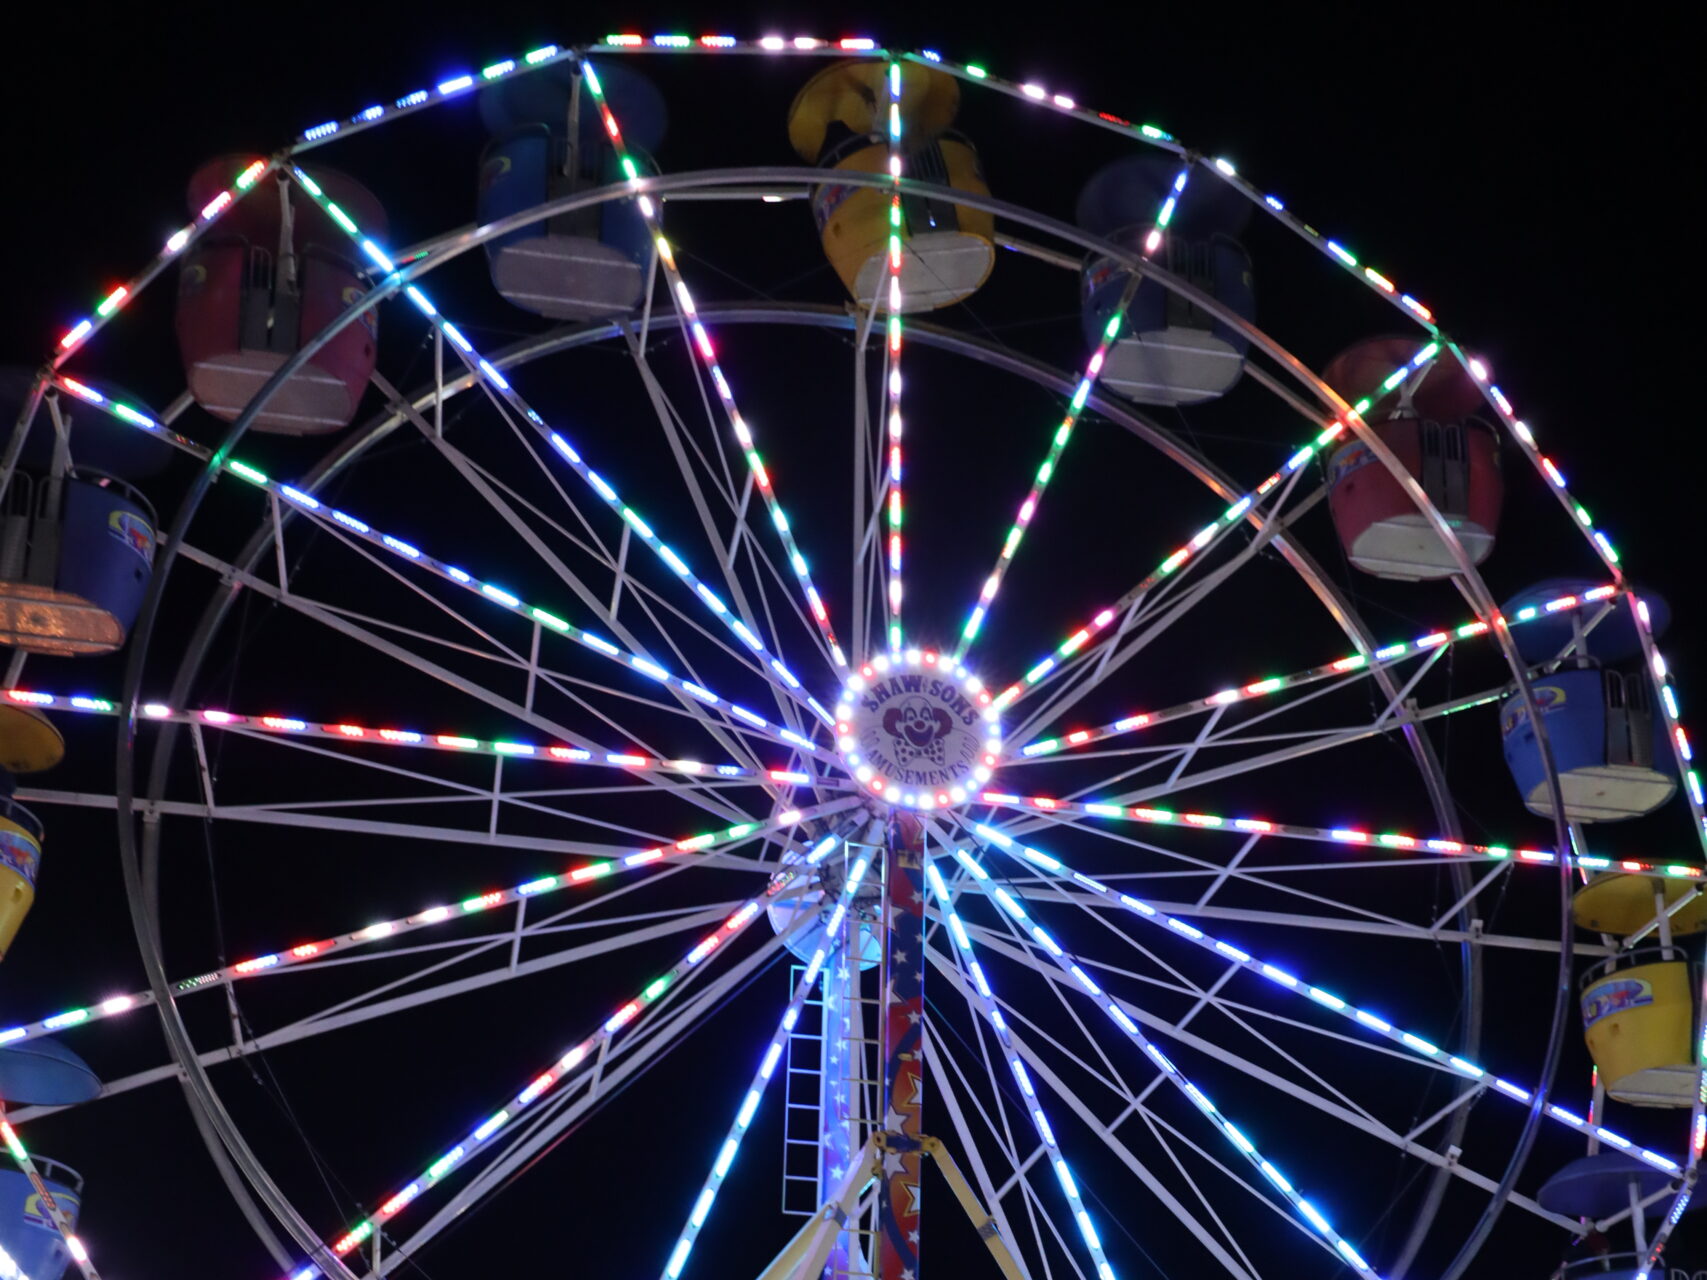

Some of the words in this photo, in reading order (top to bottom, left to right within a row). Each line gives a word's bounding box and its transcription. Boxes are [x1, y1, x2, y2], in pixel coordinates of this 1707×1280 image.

[861, 675, 923, 713] SHAW
[929, 680, 981, 726] SONS
[866, 749, 971, 787] AMUSEMENTS
